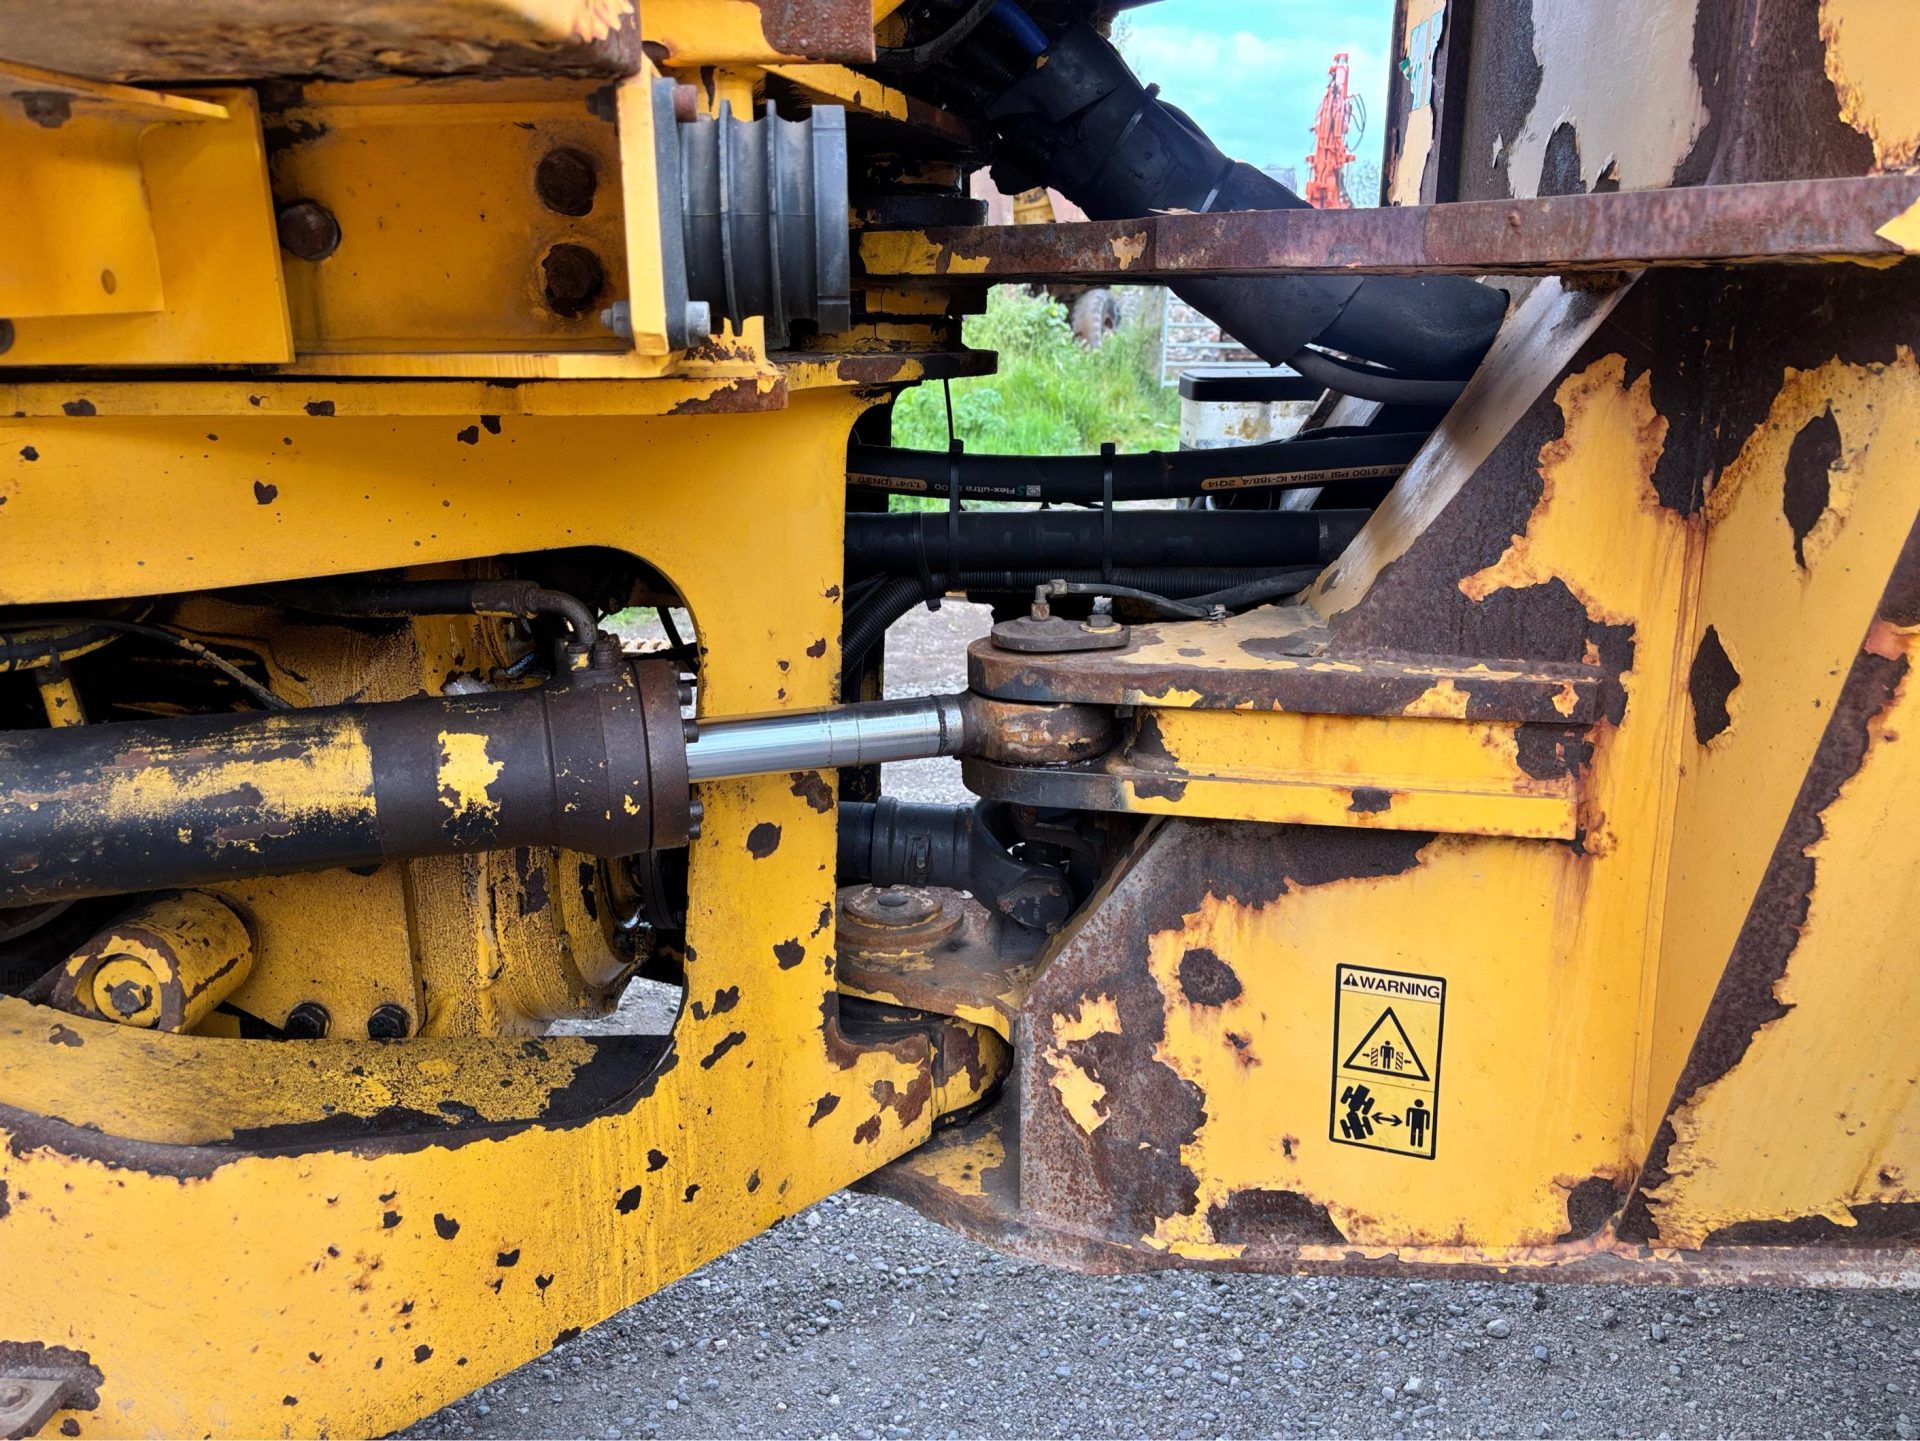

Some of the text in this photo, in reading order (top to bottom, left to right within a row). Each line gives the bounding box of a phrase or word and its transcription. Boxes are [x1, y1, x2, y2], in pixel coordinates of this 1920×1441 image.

[1290, 473, 1324, 482] MSHA
[1331, 471, 1349, 479] PSI
[1208, 480, 1235, 488] 2Q14
[966, 485, 1015, 495] Flex-ultra
[1360, 975, 1440, 999] WARNING
